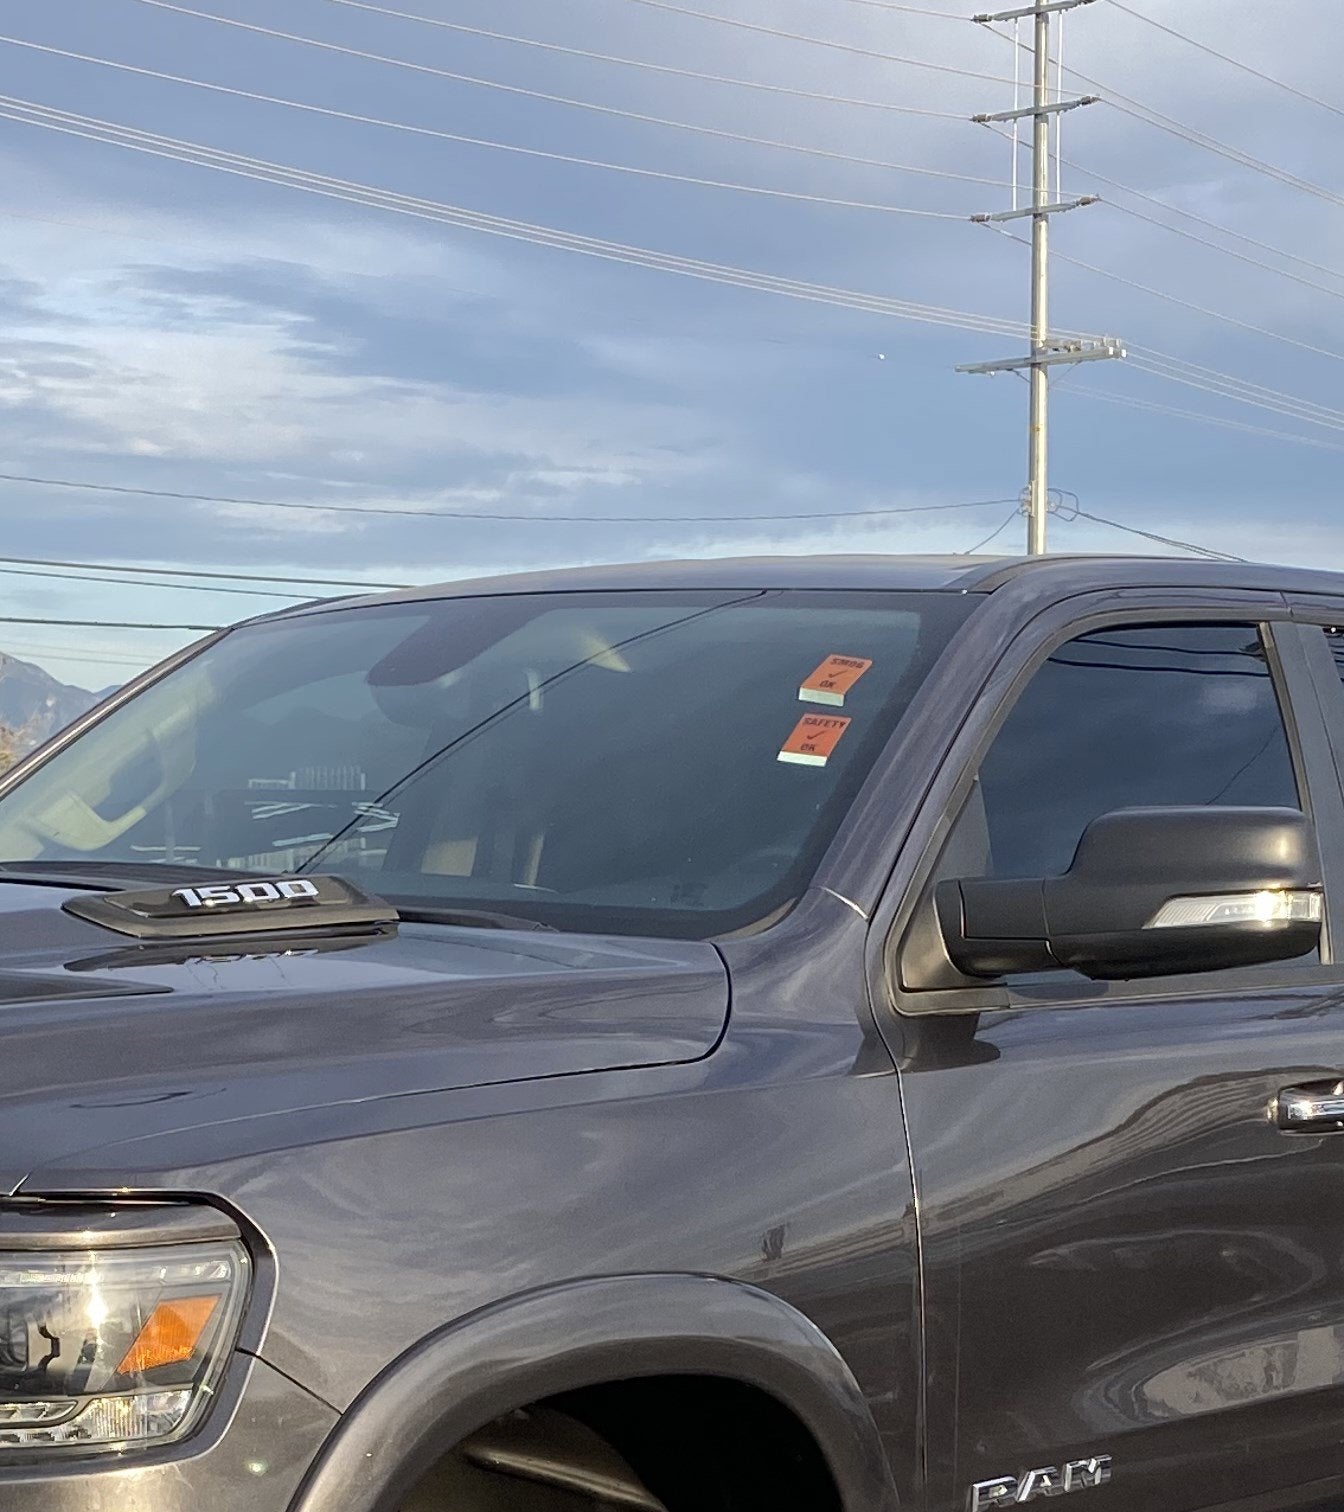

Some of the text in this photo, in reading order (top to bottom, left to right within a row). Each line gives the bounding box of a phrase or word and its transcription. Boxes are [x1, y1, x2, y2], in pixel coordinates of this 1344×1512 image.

[819, 679, 837, 689] OK
[802, 717, 846, 729] SAFETY
[800, 743, 818, 752] OK
[171, 879, 320, 908] 1500
